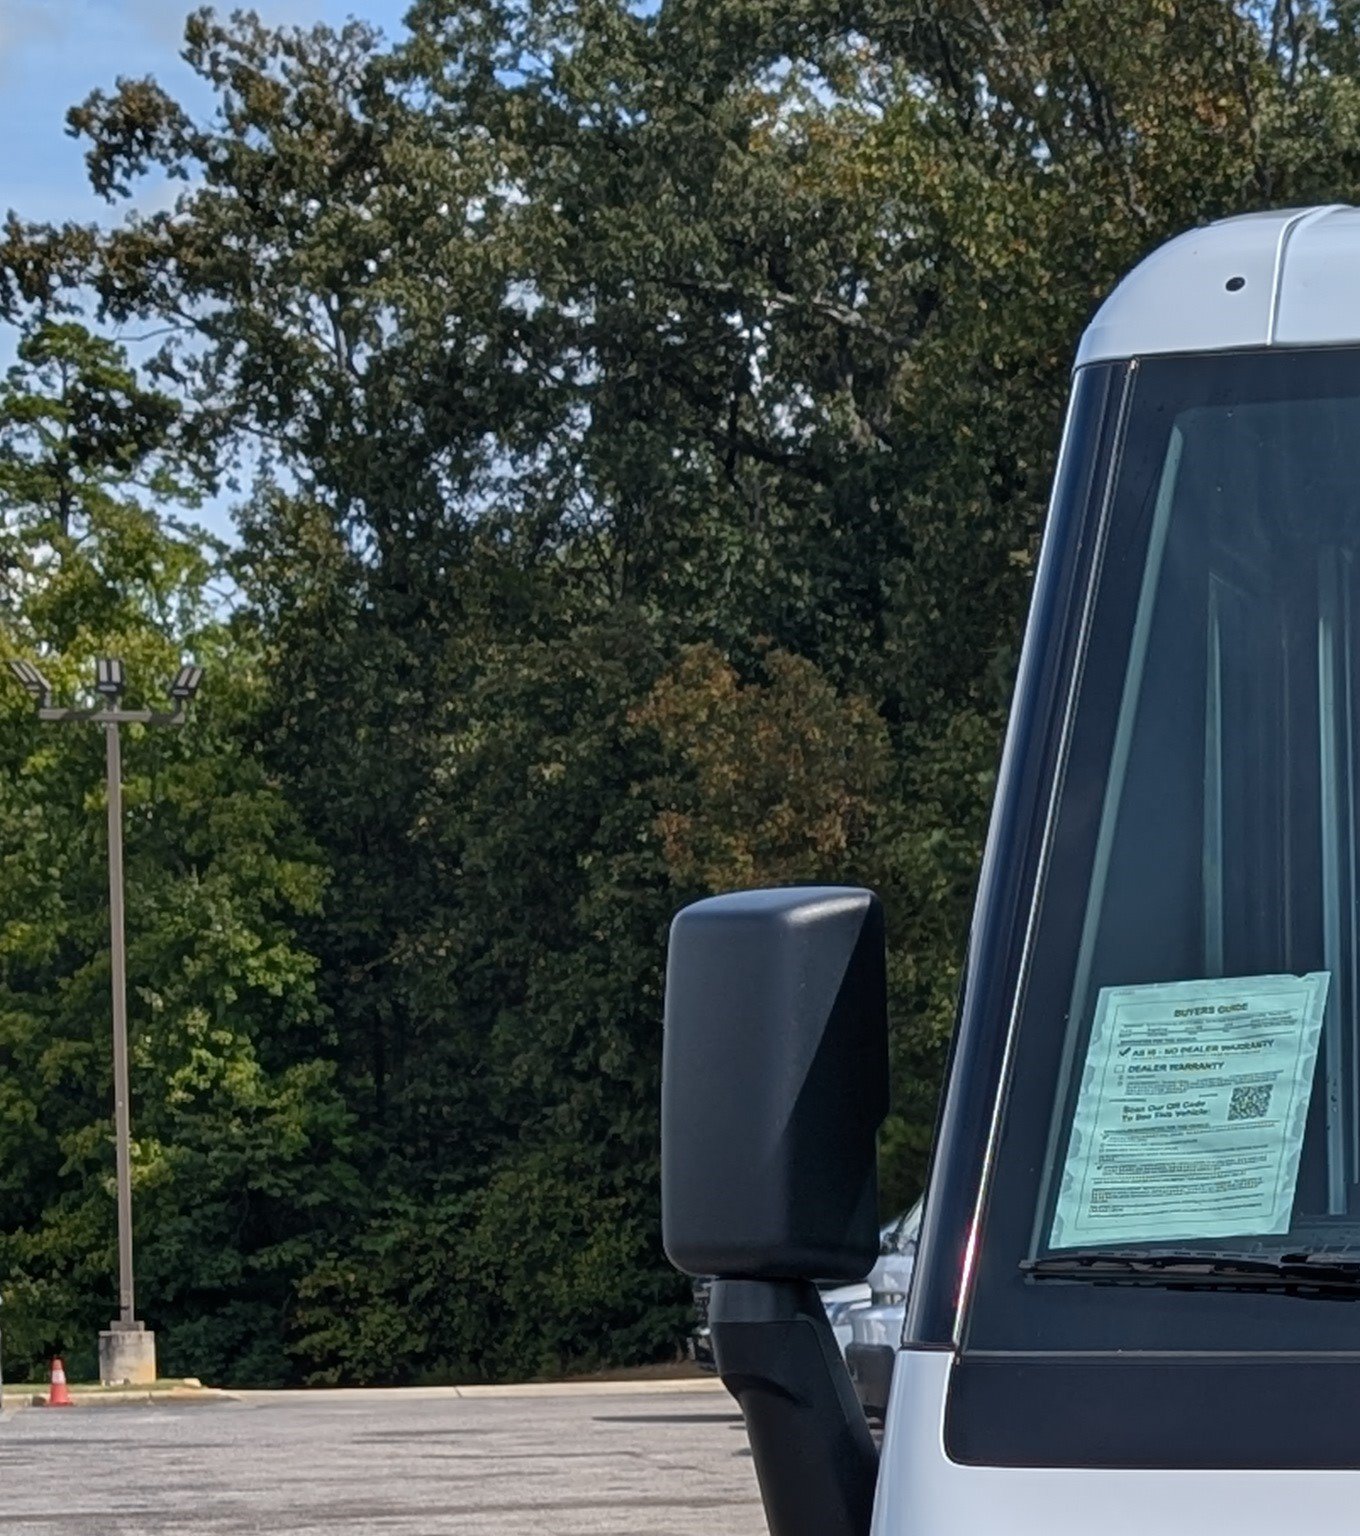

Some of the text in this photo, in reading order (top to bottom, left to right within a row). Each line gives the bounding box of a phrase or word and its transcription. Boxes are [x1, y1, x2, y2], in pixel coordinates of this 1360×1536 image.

[1174, 1003, 1248, 1017] BUYERS GUIDE
[1180, 1045, 1219, 1054] DEALER
[1221, 1039, 1275, 1052] WARRANTY
[1128, 1062, 1225, 1073] DEALER WARRANTY
